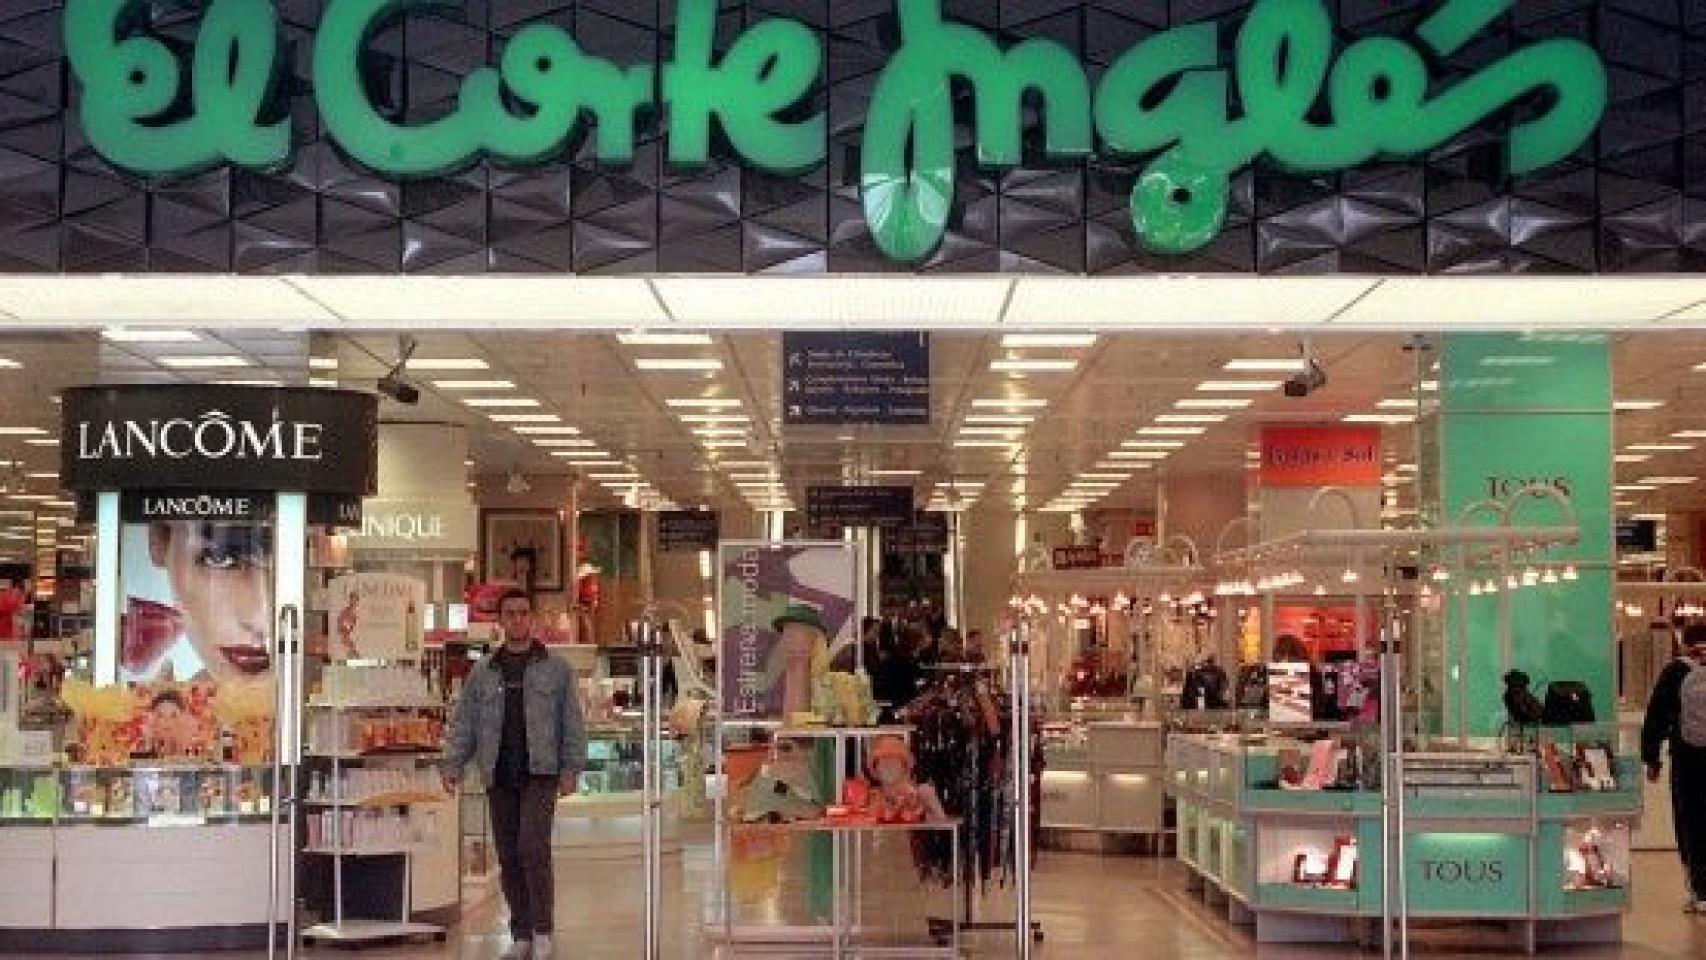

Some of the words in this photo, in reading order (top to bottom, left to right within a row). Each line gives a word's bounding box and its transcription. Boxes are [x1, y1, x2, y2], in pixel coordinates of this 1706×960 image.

[64, 0, 292, 175] El
[312, 0, 828, 176] Corte
[860, 0, 1607, 260] Inglés
[78, 408, 323, 459] LANCÔME
[143, 495, 249, 515] LANCÔME
[1421, 860, 1503, 882] TOUS
